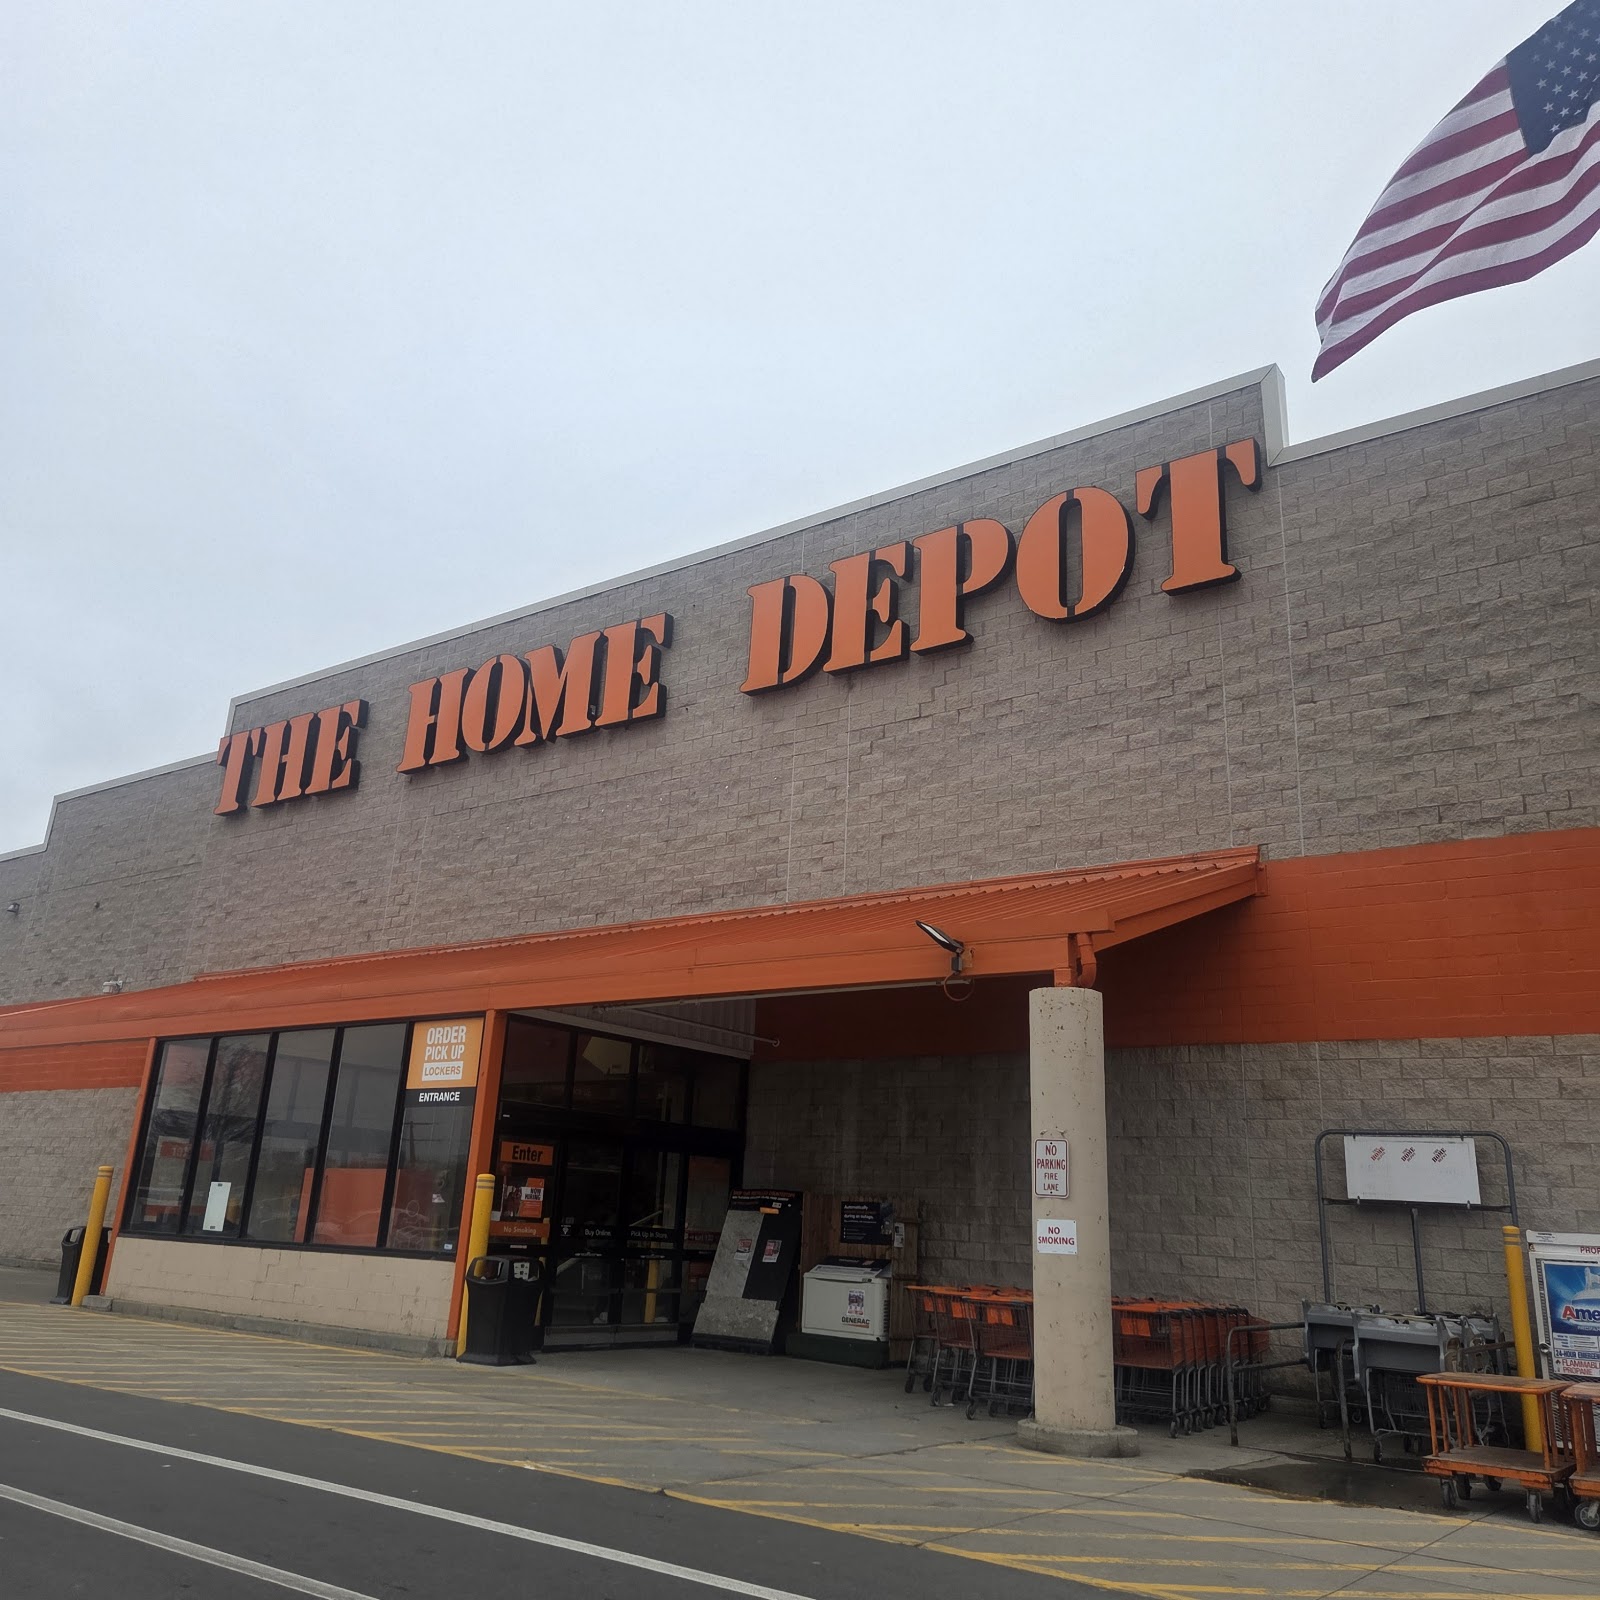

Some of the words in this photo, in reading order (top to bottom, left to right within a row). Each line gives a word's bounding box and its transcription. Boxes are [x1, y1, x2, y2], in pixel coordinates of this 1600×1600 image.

[213, 699, 368, 815] THE
[397, 612, 673, 776] HOME
[740, 437, 1261, 697] DEPOT
[427, 1025, 467, 1045] ORDER
[424, 1046, 448, 1061] PICK
[451, 1044, 465, 1059] UP
[424, 1066, 461, 1076] LOCKERS
[418, 1091, 461, 1102] ENTRANCE
[512, 1145, 543, 1162] Enter
[1045, 1145, 1057, 1156] NO
[1370, 1146, 1385, 1161] HOME
[1400, 1146, 1416, 1162] HOME
[1431, 1147, 1447, 1163] HOME
[1037, 1159, 1065, 1170] PARKING
[1044, 1172, 1058, 1180] FIRE
[1043, 1183, 1059, 1191] LANE
[513, 1227, 537, 1236] Smoking
[584, 1228, 594, 1238] Buy
[595, 1228, 612, 1236] Online
[641, 1231, 649, 1239] Up
[1048, 1226, 1060, 1235] NO
[1038, 1236, 1075, 1246] SMOKING
[1555, 1350, 1577, 1358] 24-HOUR
[1562, 1358, 1600, 1369] FLAMMABL
[1563, 1367, 1593, 1375] PROPANE
